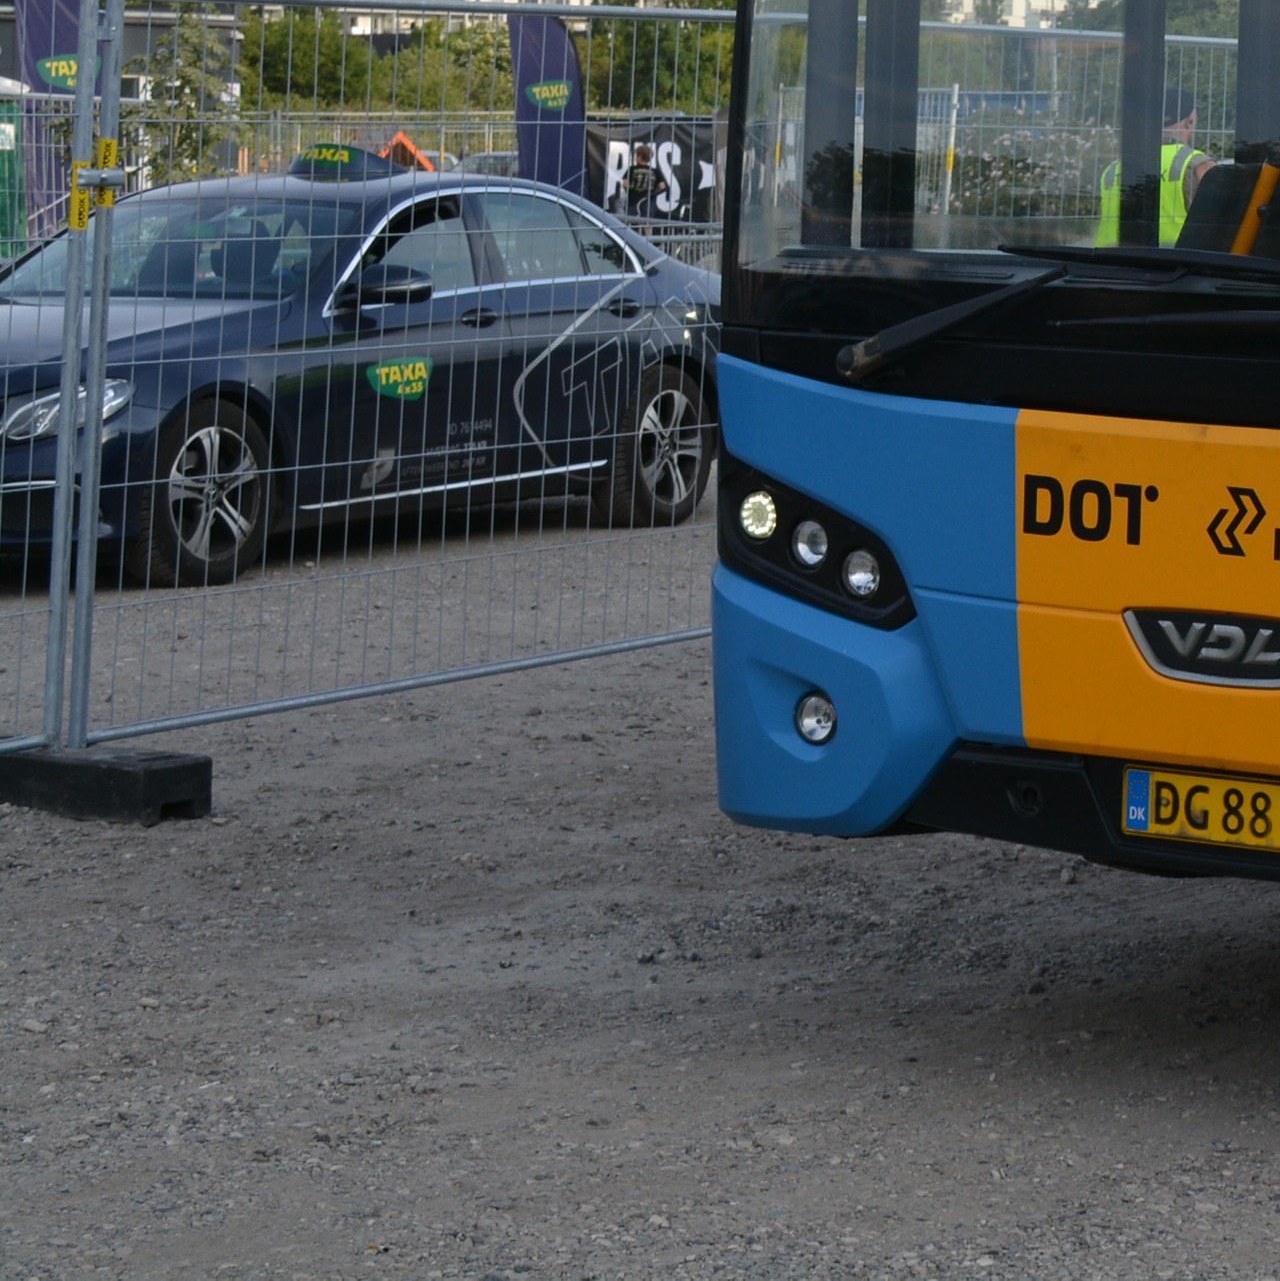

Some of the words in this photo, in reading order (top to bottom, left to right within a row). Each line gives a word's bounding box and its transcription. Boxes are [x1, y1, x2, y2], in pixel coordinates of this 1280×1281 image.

[375, 361, 428, 386] TAXA
[1022, 473, 1159, 546] DOT
[1128, 805, 1146, 822] DK
[1154, 780, 1211, 831] DG
[1221, 787, 1273, 839] 88
